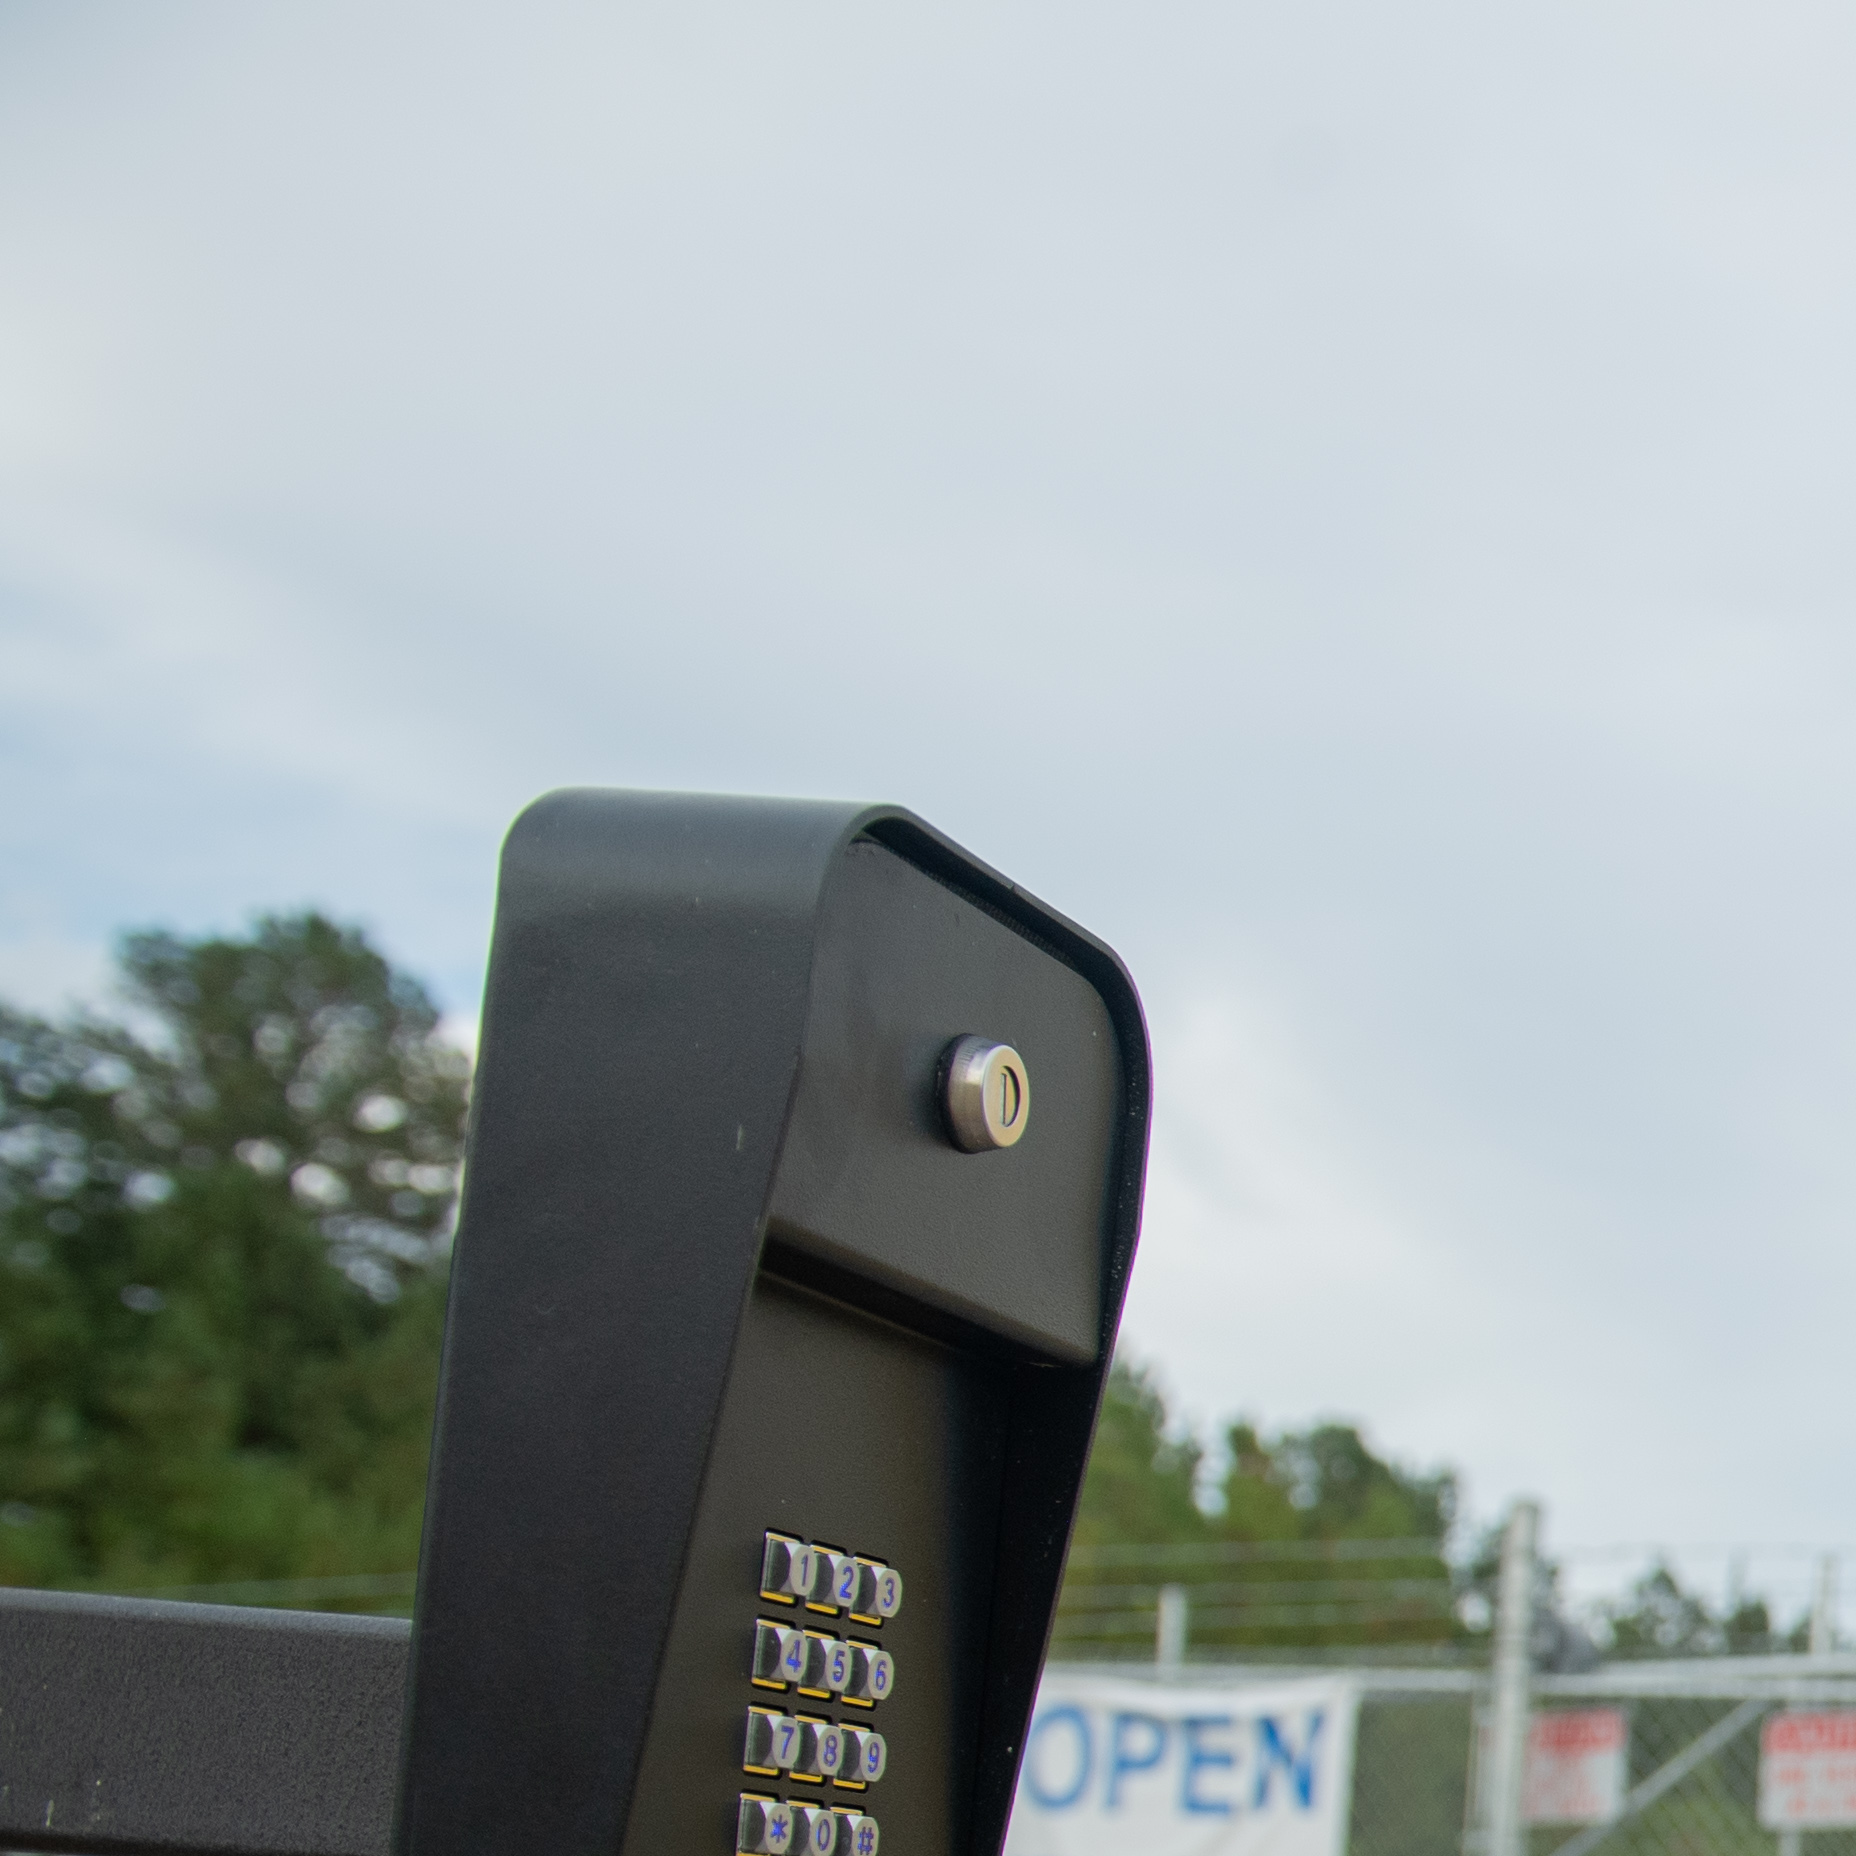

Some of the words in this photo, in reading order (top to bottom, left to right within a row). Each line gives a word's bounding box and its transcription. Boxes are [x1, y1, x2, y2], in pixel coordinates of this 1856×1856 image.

[839, 1565, 854, 1600] 2
[883, 1577, 895, 1608] 3
[786, 1639, 801, 1673] 4
[832, 1650, 845, 1683] 5
[875, 1659, 887, 1691] 6
[781, 1725, 795, 1760] 7
[823, 1734, 838, 1767] 8
[867, 1742, 880, 1773] 9
[1024, 1703, 1326, 1820] OPEN
